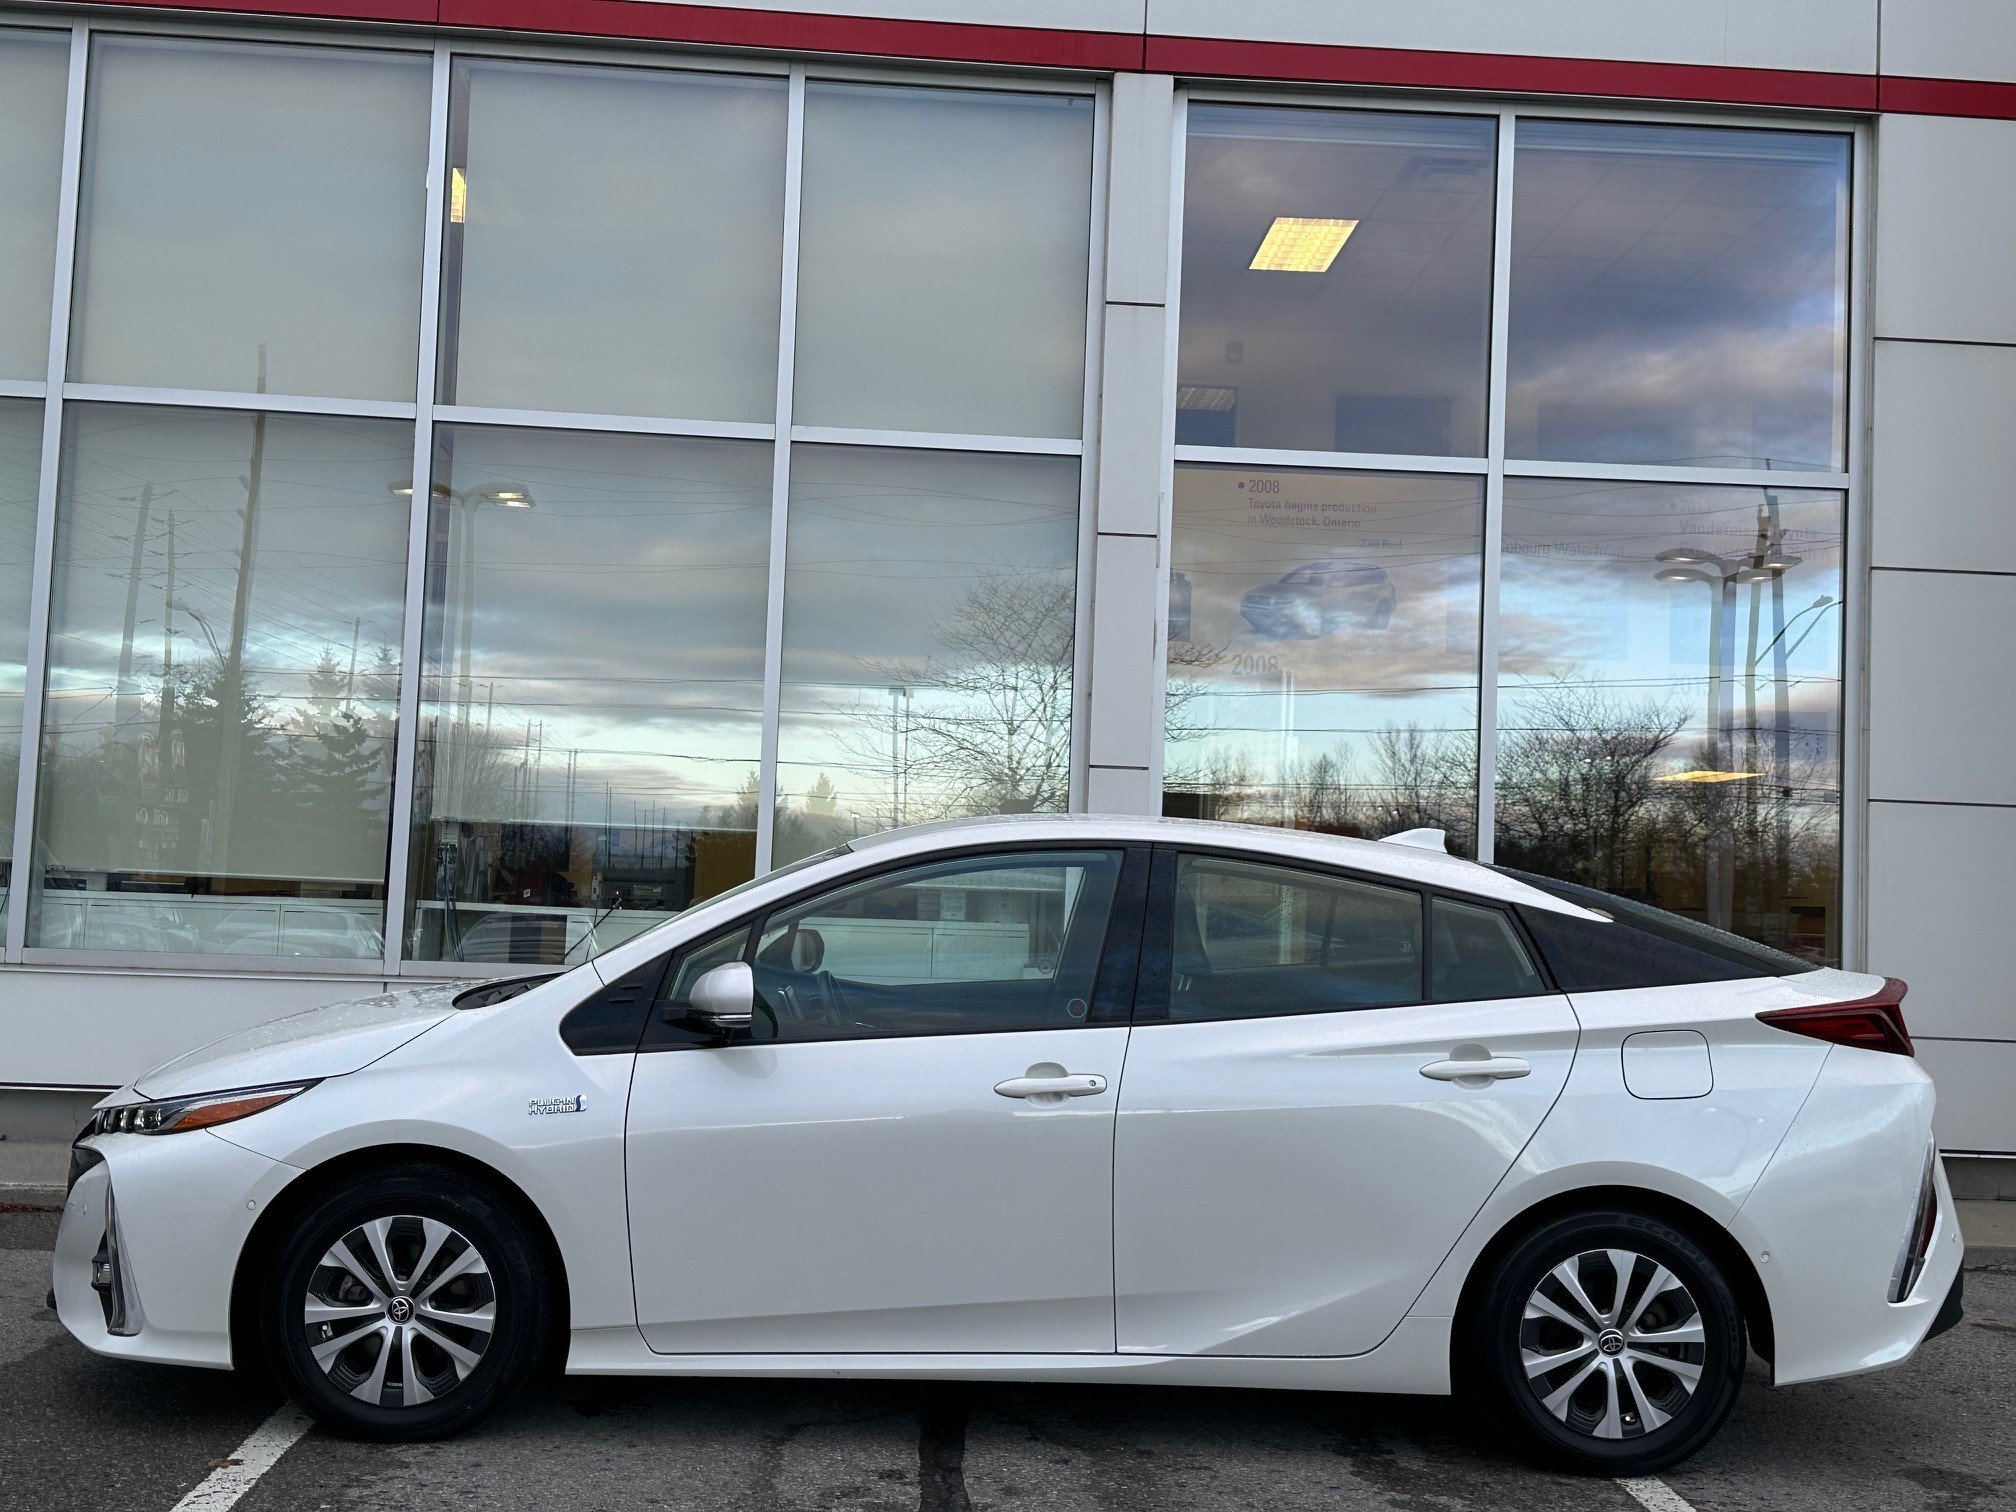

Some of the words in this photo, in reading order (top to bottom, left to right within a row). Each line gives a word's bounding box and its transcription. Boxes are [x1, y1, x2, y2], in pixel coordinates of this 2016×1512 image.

[1248, 480, 1280, 494] 2008
[1248, 498, 1281, 510] Toyota
[1285, 500, 1318, 513] begins
[1321, 503, 1377, 515] production
[1247, 515, 1257, 524] in
[1231, 654, 1278, 676] 2008
[529, 1104, 576, 1115] HYBRID
